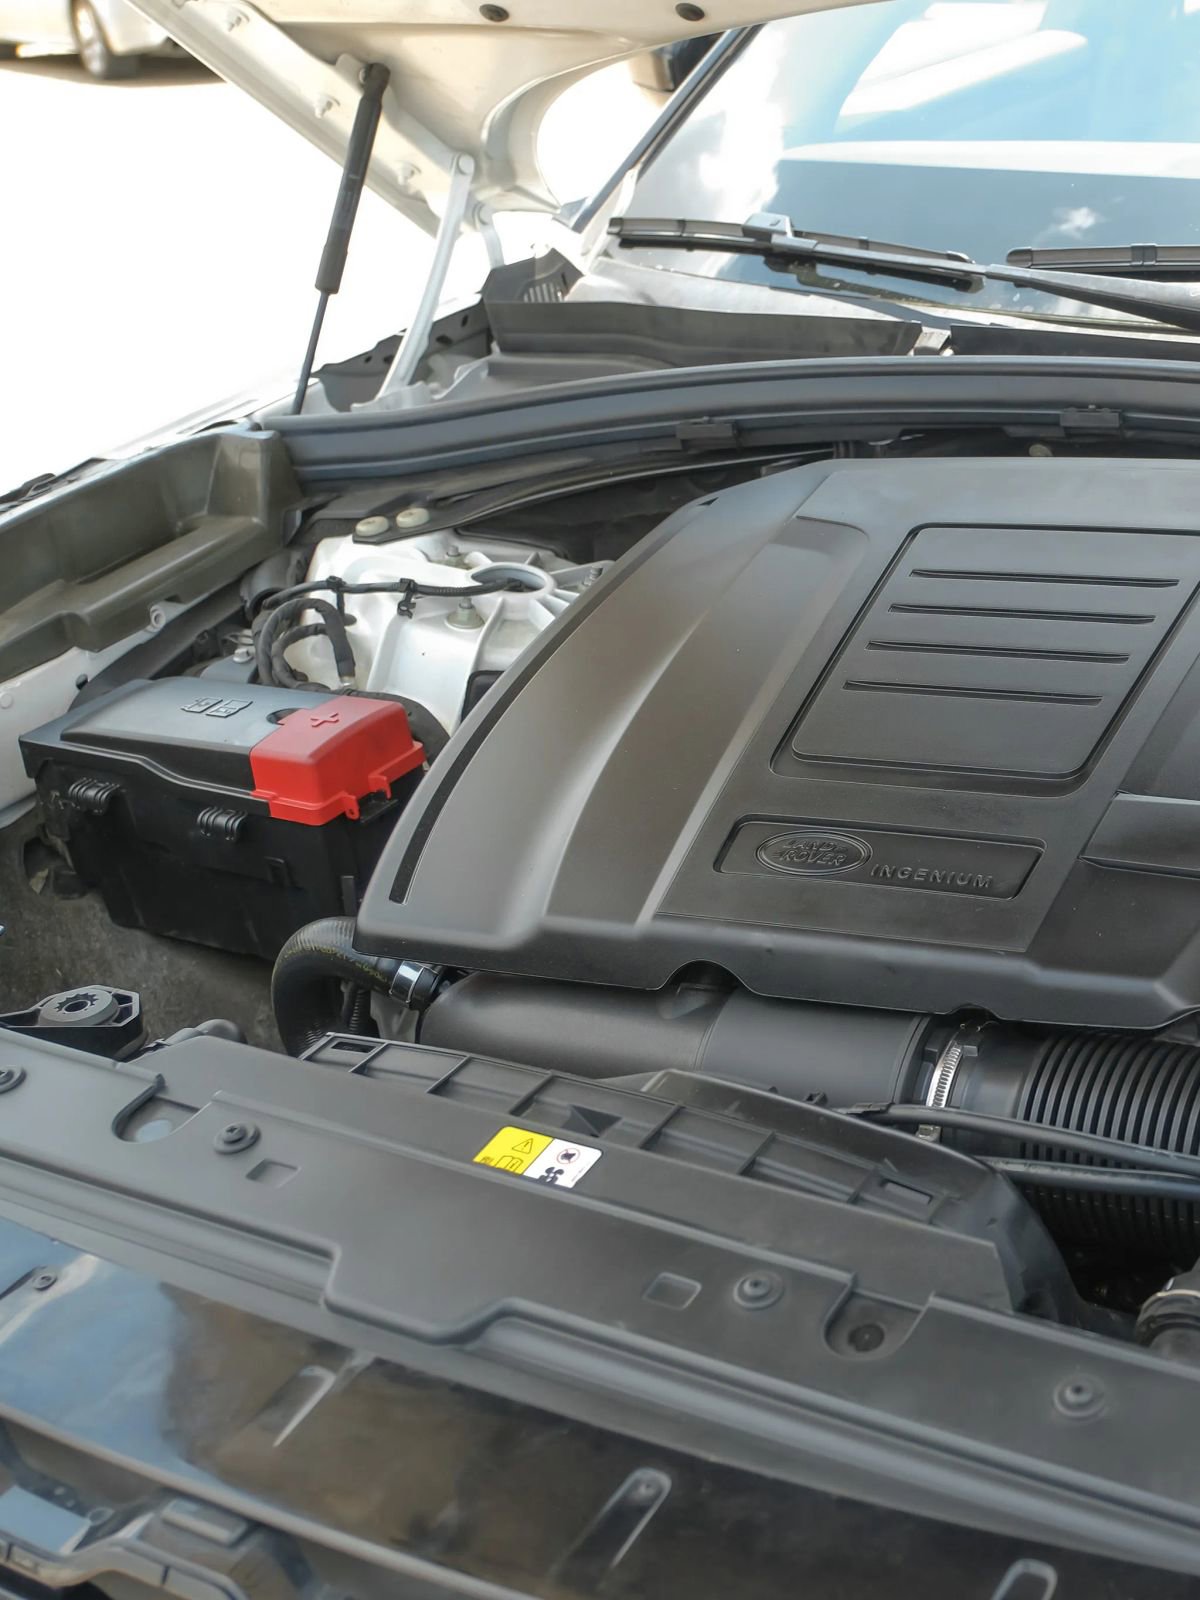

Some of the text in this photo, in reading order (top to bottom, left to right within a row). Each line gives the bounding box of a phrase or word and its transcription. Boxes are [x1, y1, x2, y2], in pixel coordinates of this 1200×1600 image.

[782, 839, 837, 851] LAND
[779, 849, 847, 866] ROVER
[870, 863, 993, 888] INGENIUM
